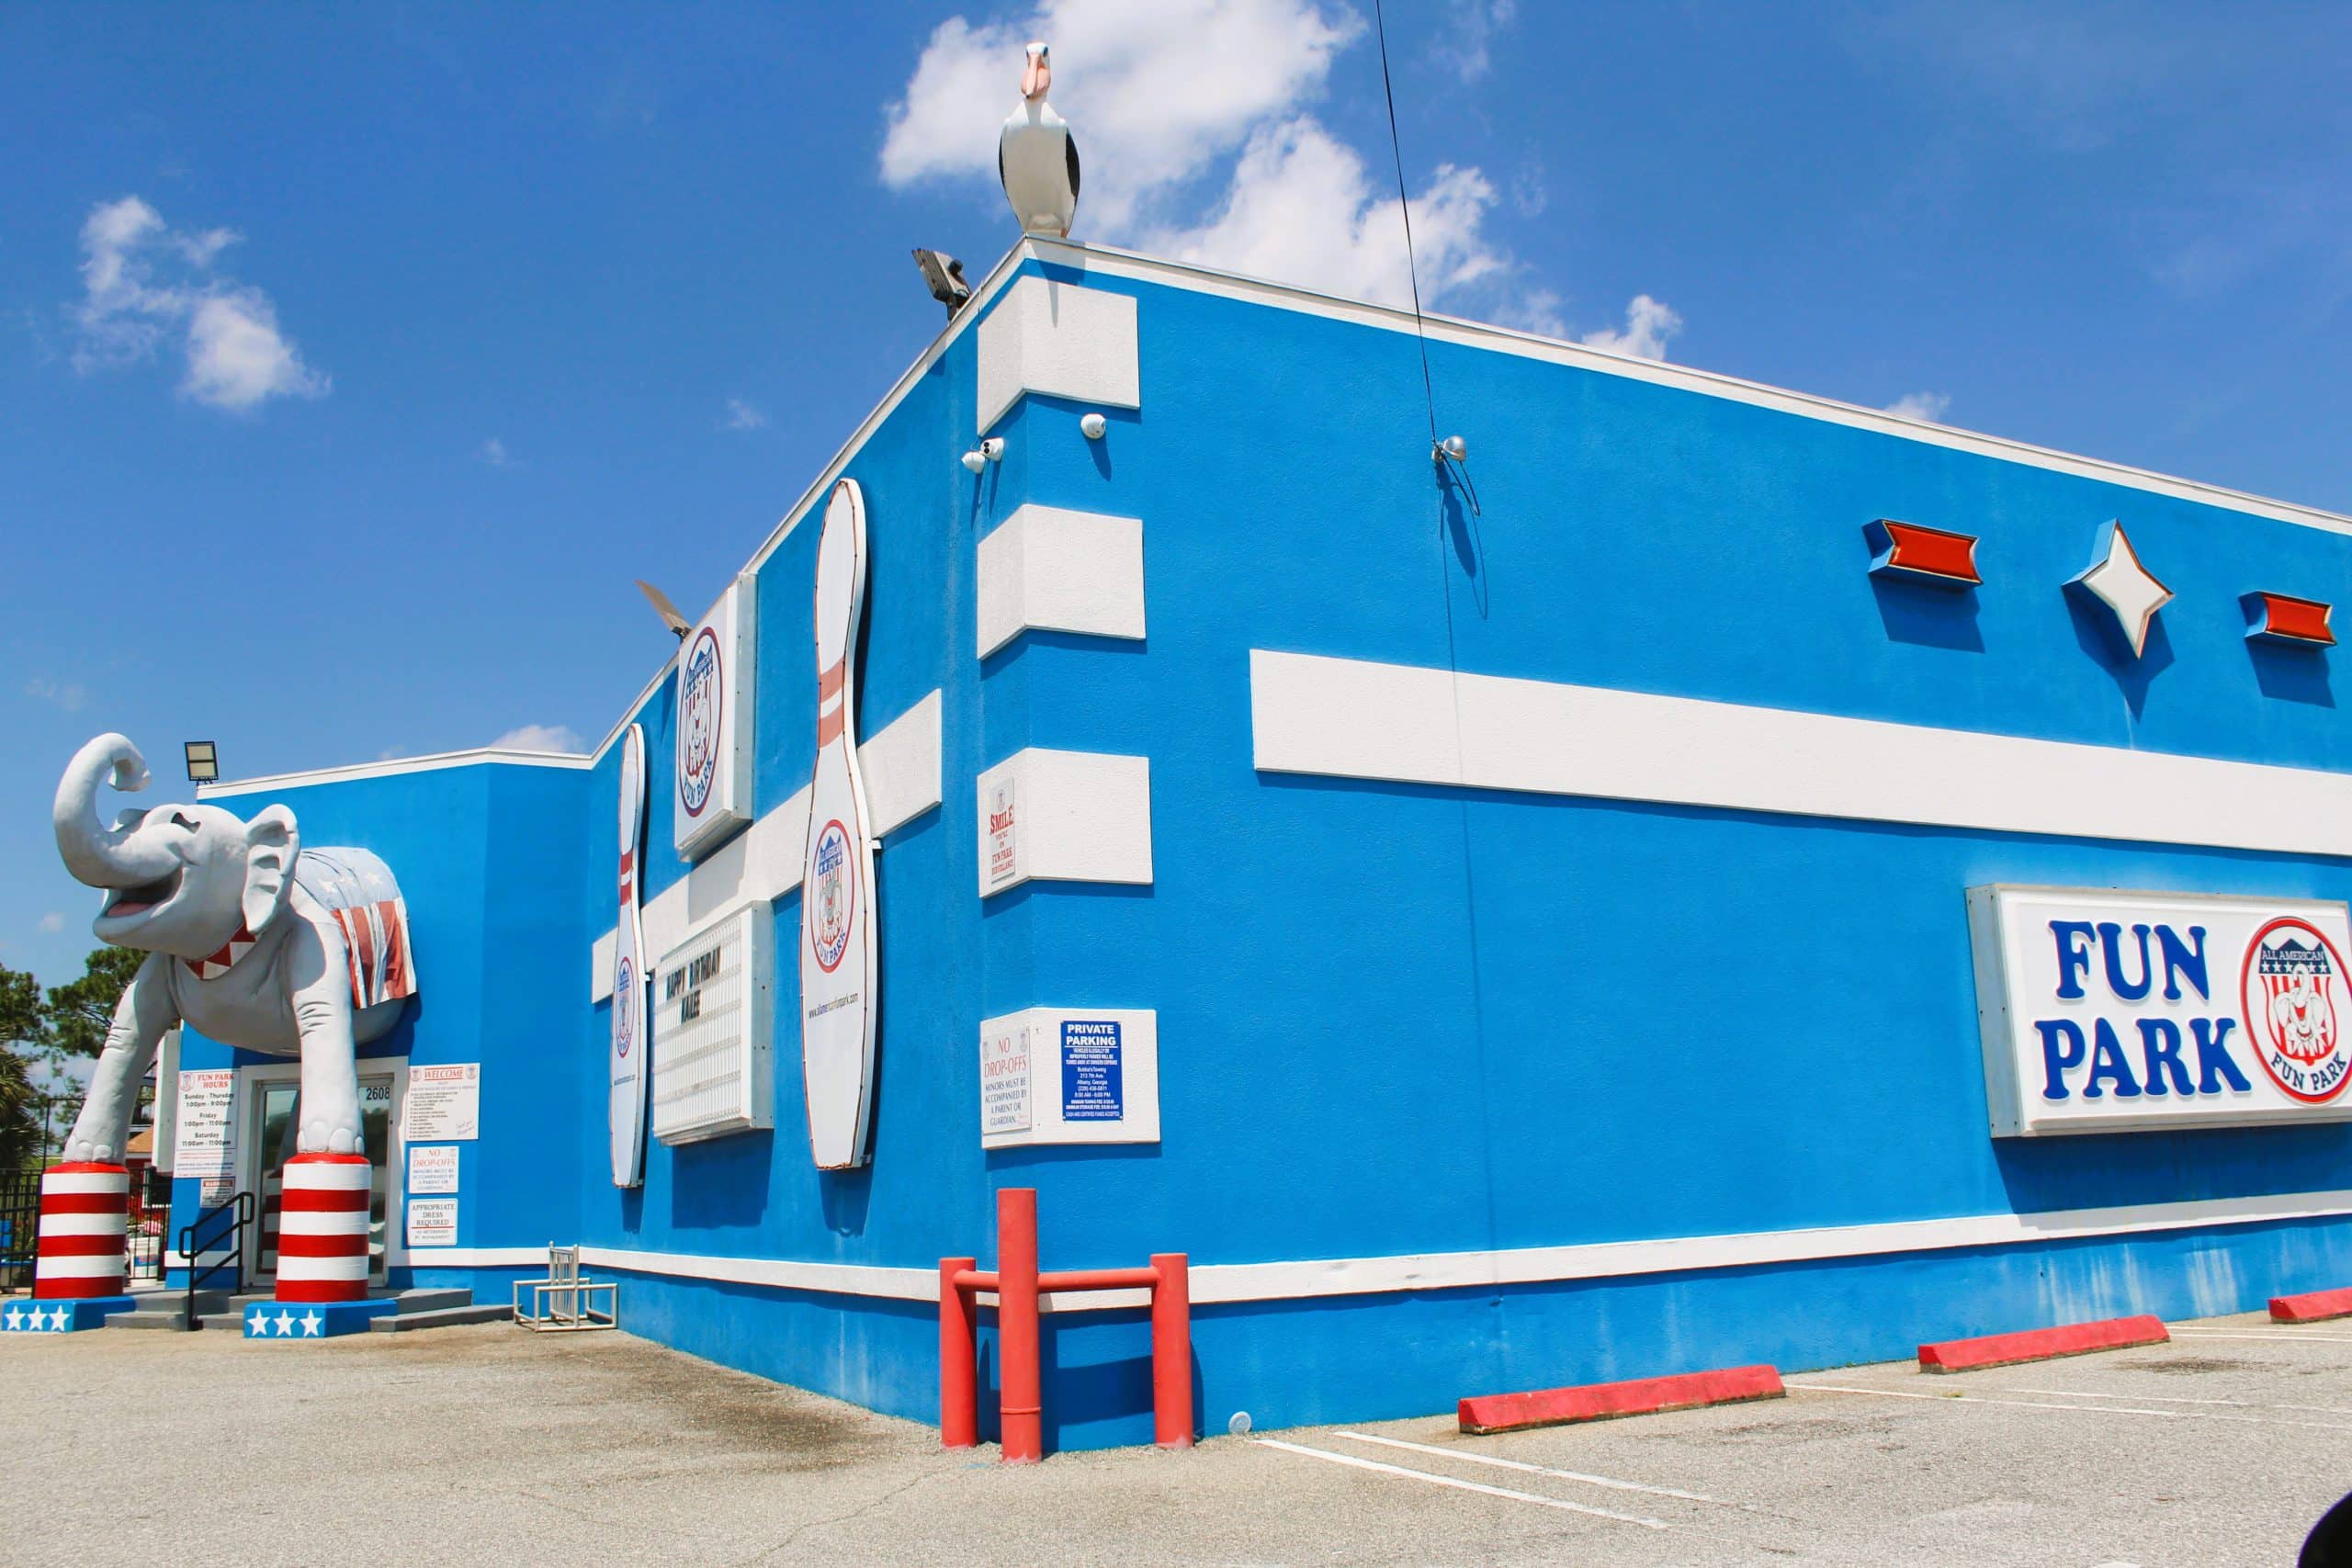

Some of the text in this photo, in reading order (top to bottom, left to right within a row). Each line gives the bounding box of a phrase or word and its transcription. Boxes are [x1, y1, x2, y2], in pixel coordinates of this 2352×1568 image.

[989, 805, 1014, 835] SMILE
[992, 847, 1012, 864] FUN PARK
[2262, 950, 2324, 961] ALL AMERICAN
[666, 966, 685, 1000] HAPPY
[2034, 920, 2252, 1100] FUN PARK
[1068, 1024, 1114, 1034] PRIVATE
[999, 1037, 1011, 1054] NO
[1066, 1035, 1116, 1045] PARKING
[424, 1069, 463, 1078] WELCOME
[984, 1055, 1026, 1077] DROP-OFFS
[2271, 1051, 2346, 1091] FUN PARK
[985, 1077, 1026, 1092] MINORS MUST BE
[367, 1087, 390, 1100] 2608
[985, 1089, 1027, 1103] ACCOMPANIED BY
[995, 1102, 1012, 1114] PARENT
[1013, 1102, 1021, 1111] OR
